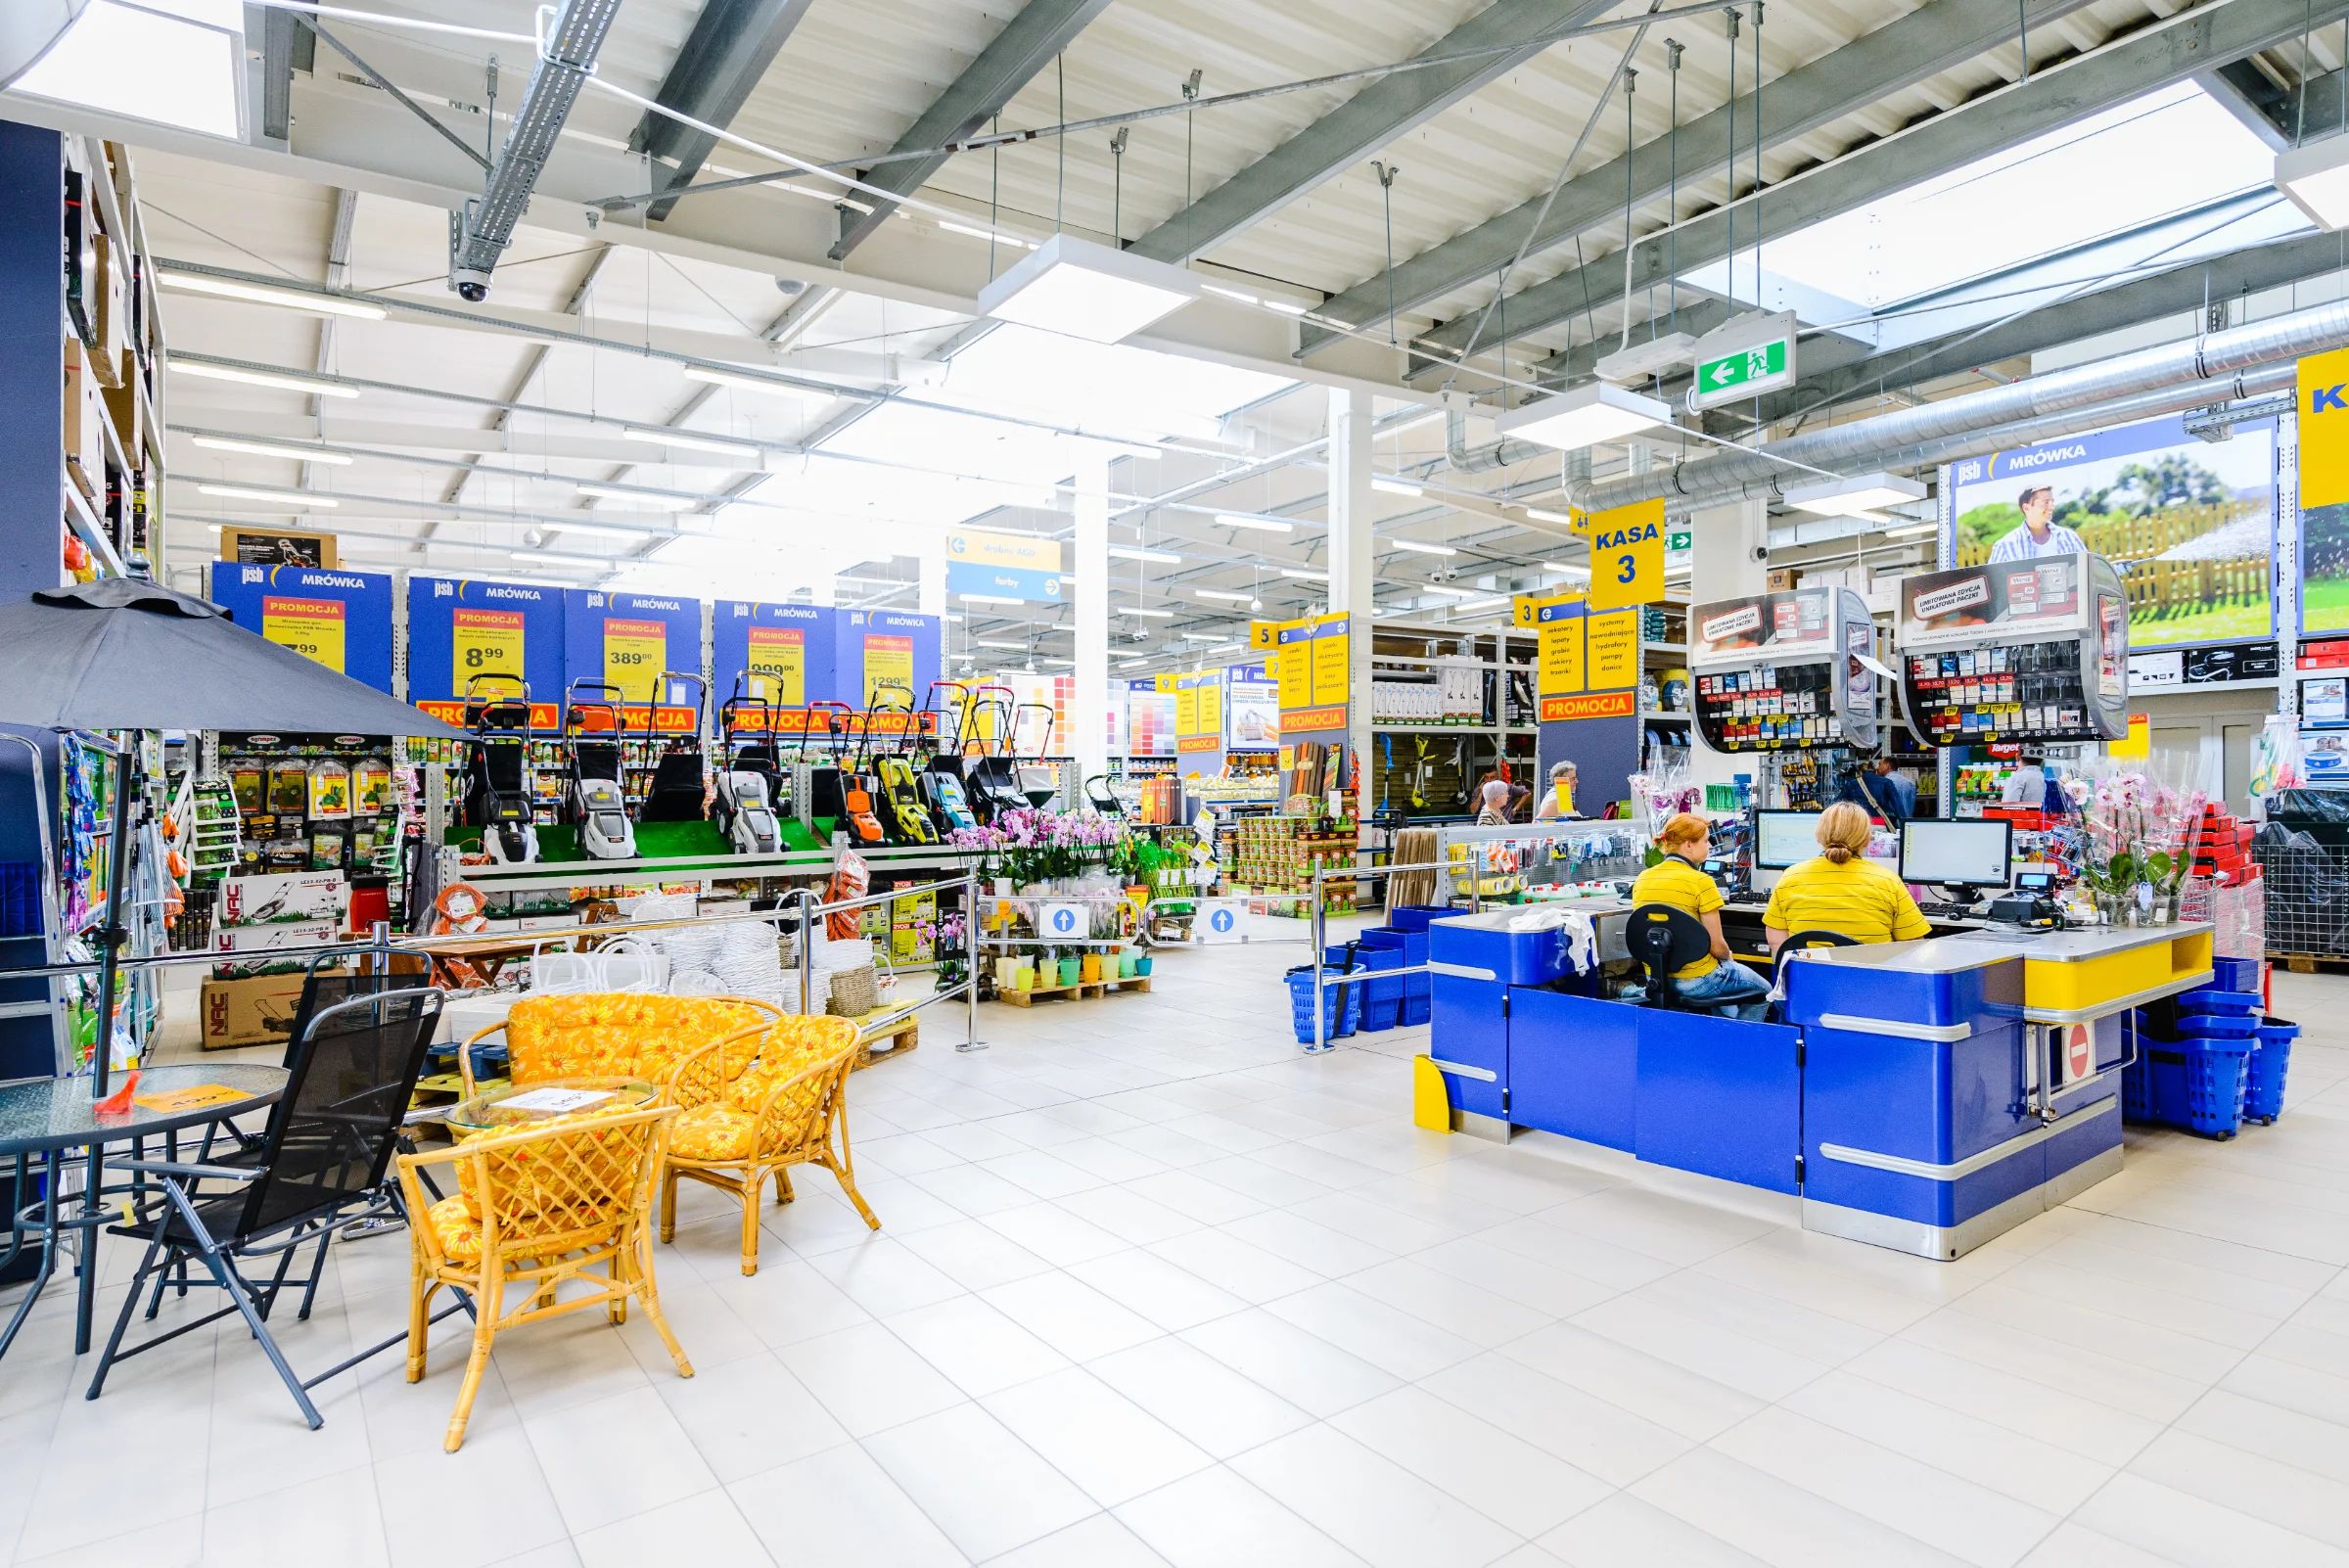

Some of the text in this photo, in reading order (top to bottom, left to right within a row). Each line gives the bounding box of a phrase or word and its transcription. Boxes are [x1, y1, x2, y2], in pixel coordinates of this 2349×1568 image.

[1958, 444, 2087, 485] psb MRÓWKA
[1596, 523, 1659, 550] KASA
[1617, 554, 1635, 583] 3
[242, 567, 365, 589] psb MRÓWKA
[995, 576, 1019, 588] farby
[435, 581, 541, 600] psb MRÓWKA
[1919, 584, 1981, 608] LIMITOWANA EDYCJA
[269, 602, 340, 615] PROMOCJA
[587, 592, 680, 611] psb MRÓWKA
[1921, 592, 1979, 613] UNIKATOWE PACZKI
[734, 603, 818, 620] psb MRÓWKA
[1523, 605, 1531, 622] 3
[1736, 612, 1755, 622] EDYCJA
[459, 614, 519, 624] PROMOCJA
[851, 612, 925, 627] psb MRÓWKA
[1598, 619, 1625, 627] systemy
[1735, 619, 1753, 629] PACZKI
[609, 623, 662, 634] PROMOCJA
[753, 630, 800, 641] PROMOCJA
[1261, 628, 1269, 643] 5
[1547, 625, 1573, 634] sekatory
[868, 638, 909, 648] PROMOCJA
[1596, 641, 1628, 651] hydrofory
[1551, 647, 1570, 657] grabie
[1549, 658, 1572, 667] siekiery
[1547, 698, 1627, 715] PROMOCJA
[1284, 713, 1341, 727] PROMOCJA
[1180, 740, 1217, 749] PROMOCJA
[1992, 744, 2020, 753] Target
[226, 884, 240, 924] NAC
[219, 934, 232, 975] NC
[210, 993, 225, 1037] NAC
